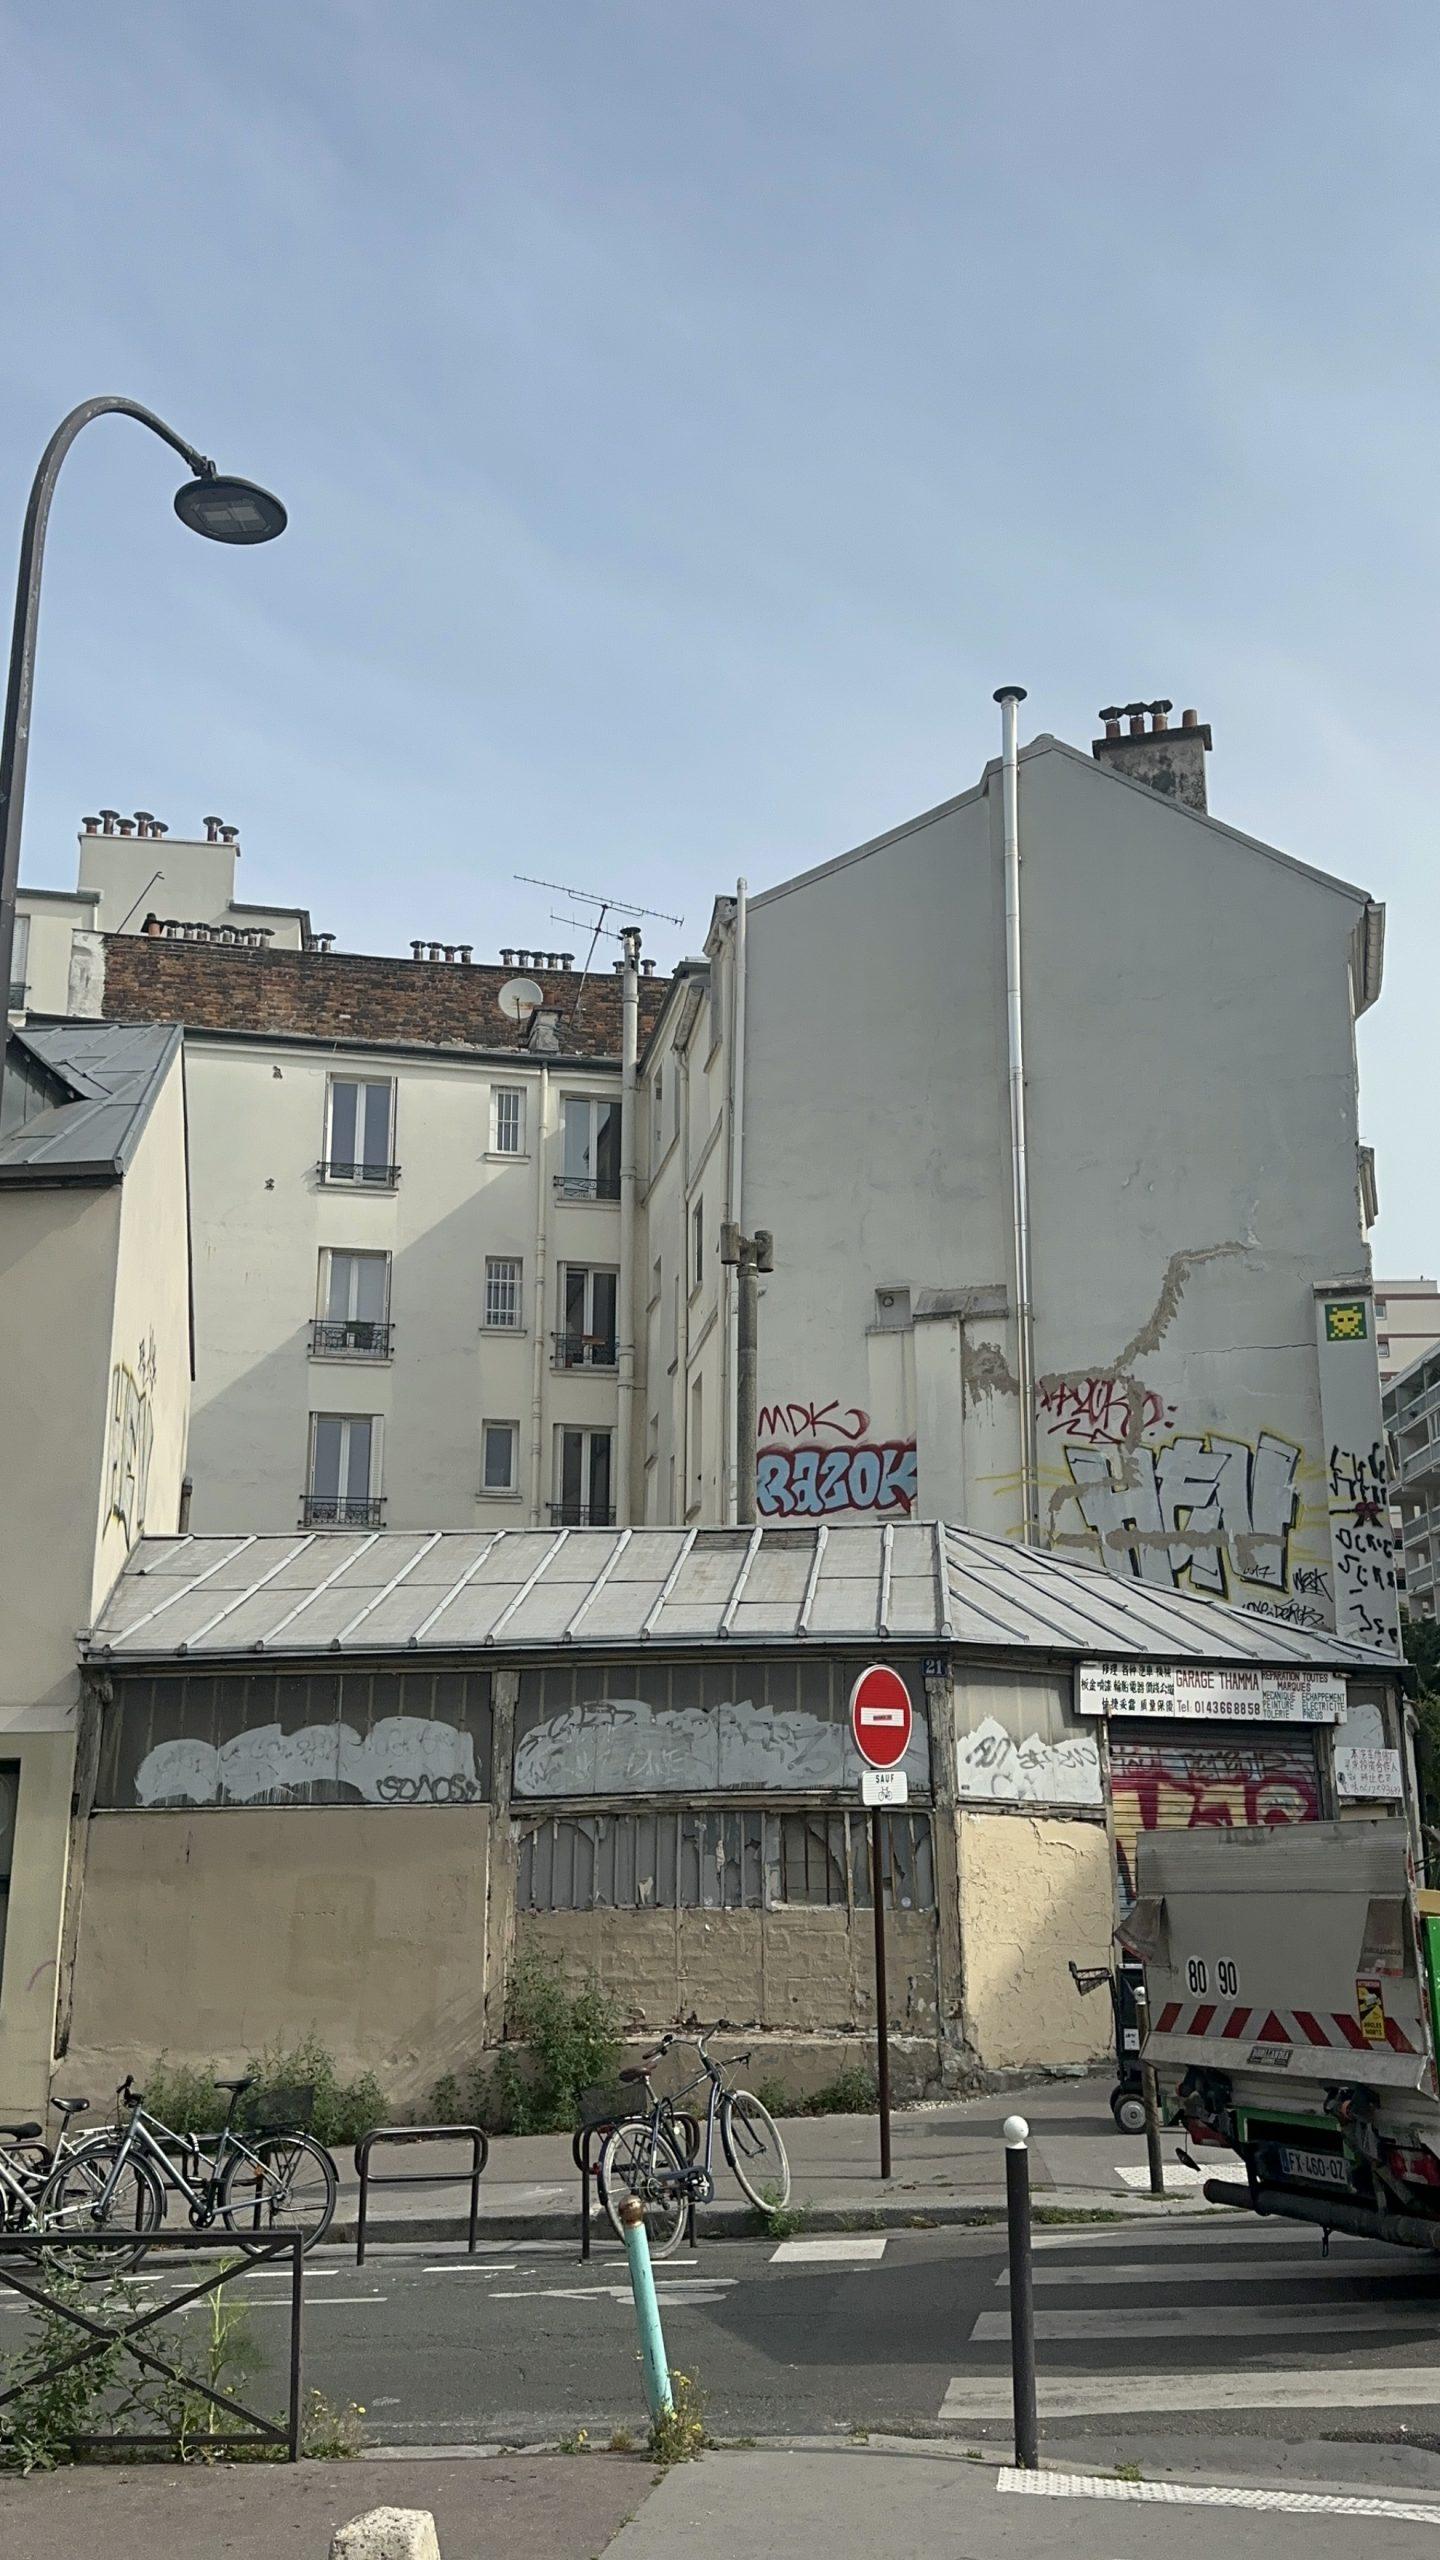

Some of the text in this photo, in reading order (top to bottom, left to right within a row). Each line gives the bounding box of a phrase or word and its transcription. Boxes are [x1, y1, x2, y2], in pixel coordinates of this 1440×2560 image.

[925, 1660, 942, 1675] 21
[1176, 1669, 1259, 1690] GARAGE THAMMA
[1262, 1671, 1328, 1683] REPARATION TOUTES
[1277, 1681, 1311, 1692] MARQUES
[1263, 1690, 1345, 1703] MECANIQUE ECHAPPEMENT
[1263, 1700, 1345, 1712] PEINTURE ELECTRICITE
[1263, 1709, 1323, 1720] TOLERIE PNEUS
[875, 1774, 894, 1784] SAUF
[1188, 1959, 1208, 1993] 80
[1218, 1960, 1238, 1995] 90
